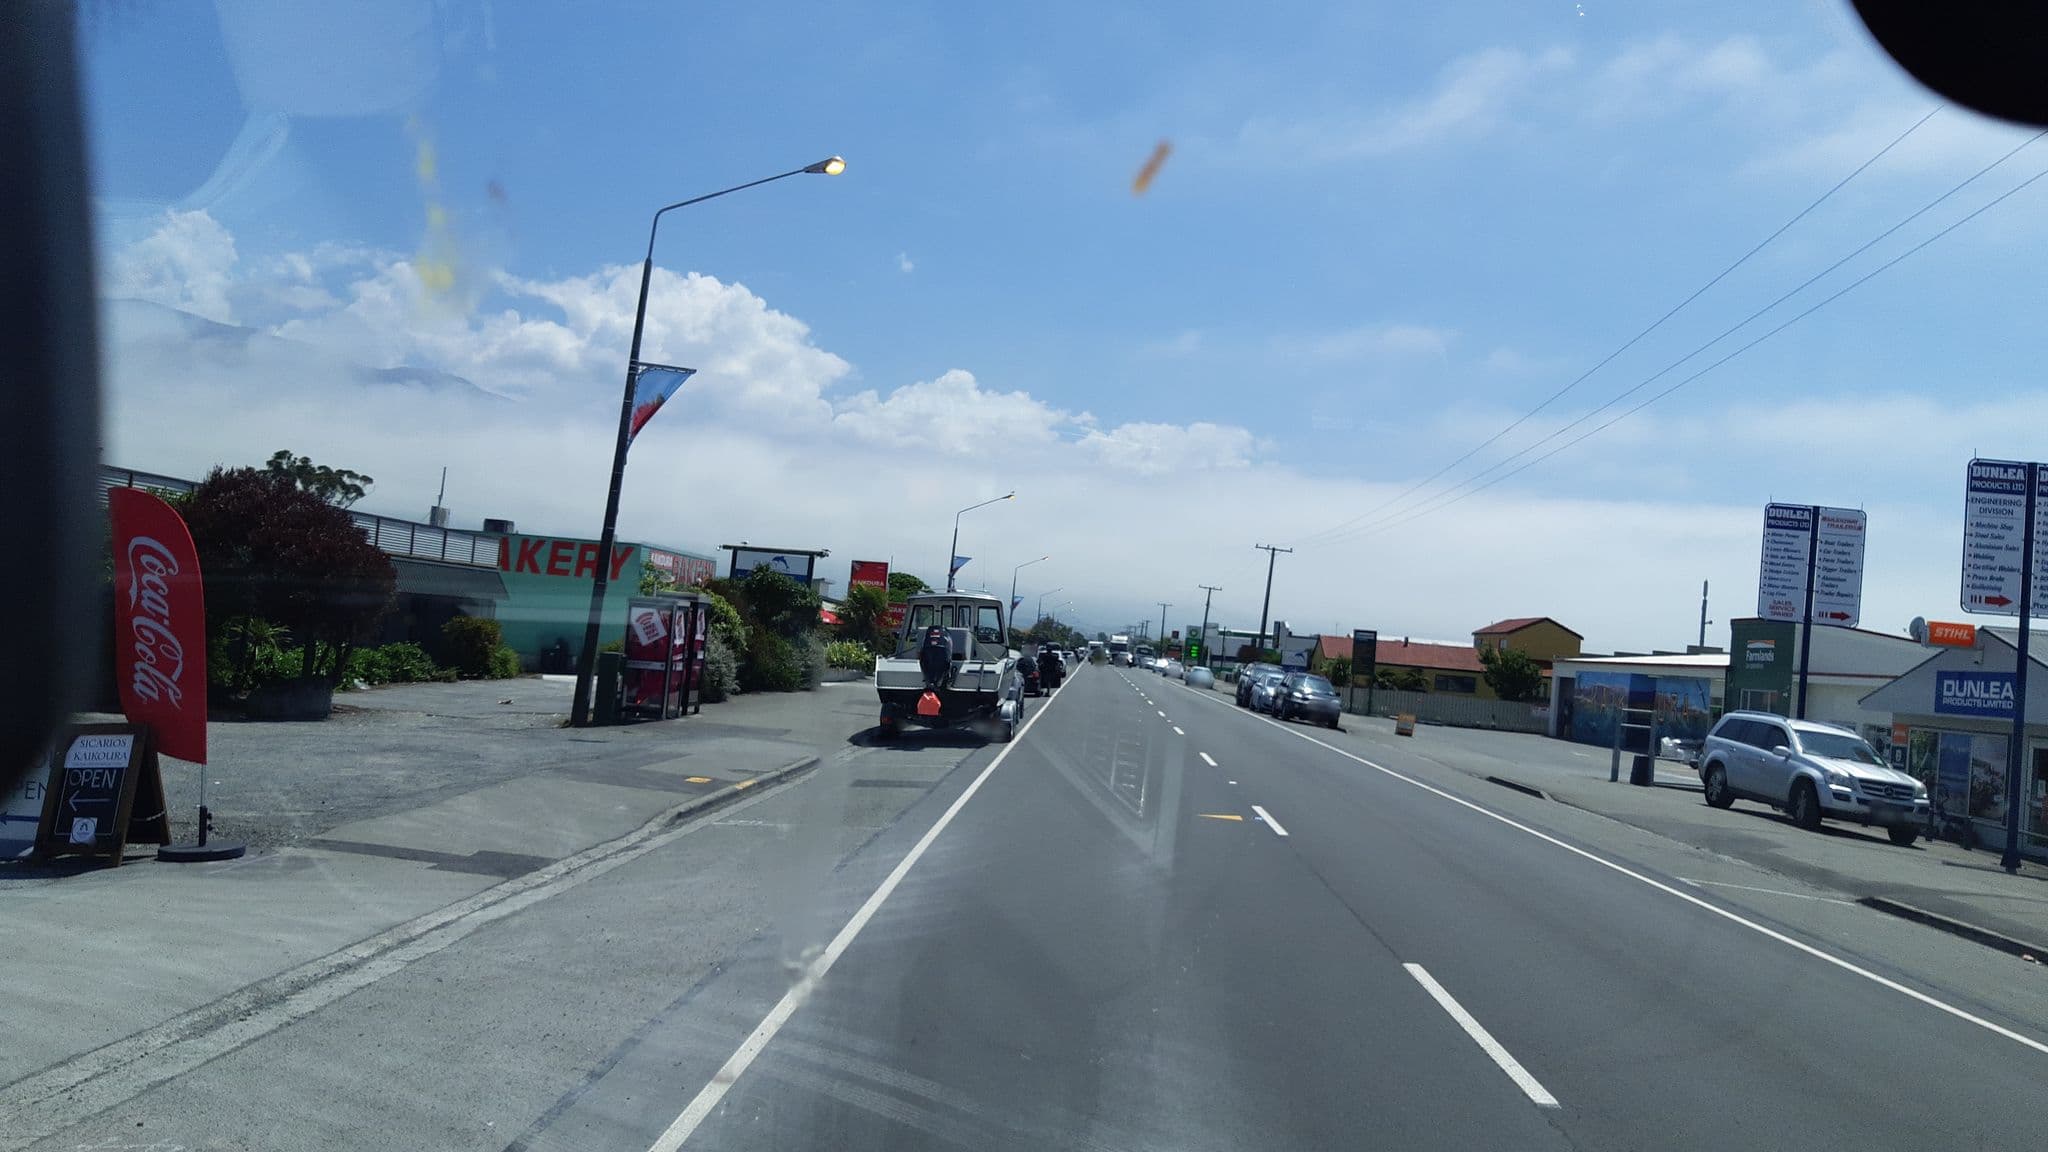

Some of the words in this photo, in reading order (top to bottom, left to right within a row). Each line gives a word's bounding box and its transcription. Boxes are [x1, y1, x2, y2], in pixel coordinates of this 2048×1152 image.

[1972, 466, 2025, 480] DUNLEA
[1971, 480, 2011, 491] PRODUCTS
[2012, 482, 2025, 491] LTD
[1970, 497, 2022, 507] ENGINEERING
[1769, 508, 1810, 520] DUNLEA
[1979, 507, 2014, 516] DIVISION
[1768, 519, 1798, 528] PRODUCTS
[2000, 523, 2014, 531] Shop
[1973, 553, 1996, 562] Welding
[1934, 627, 1971, 640] STIHL
[1943, 679, 2015, 699] DUNLEA
[1942, 697, 1981, 708] PRODUCTS
[1983, 699, 2014, 710] LIMITED
[80, 739, 126, 748] SICARIOS
[74, 751, 127, 761] KAIKOURA
[69, 769, 117, 789] OPEN
